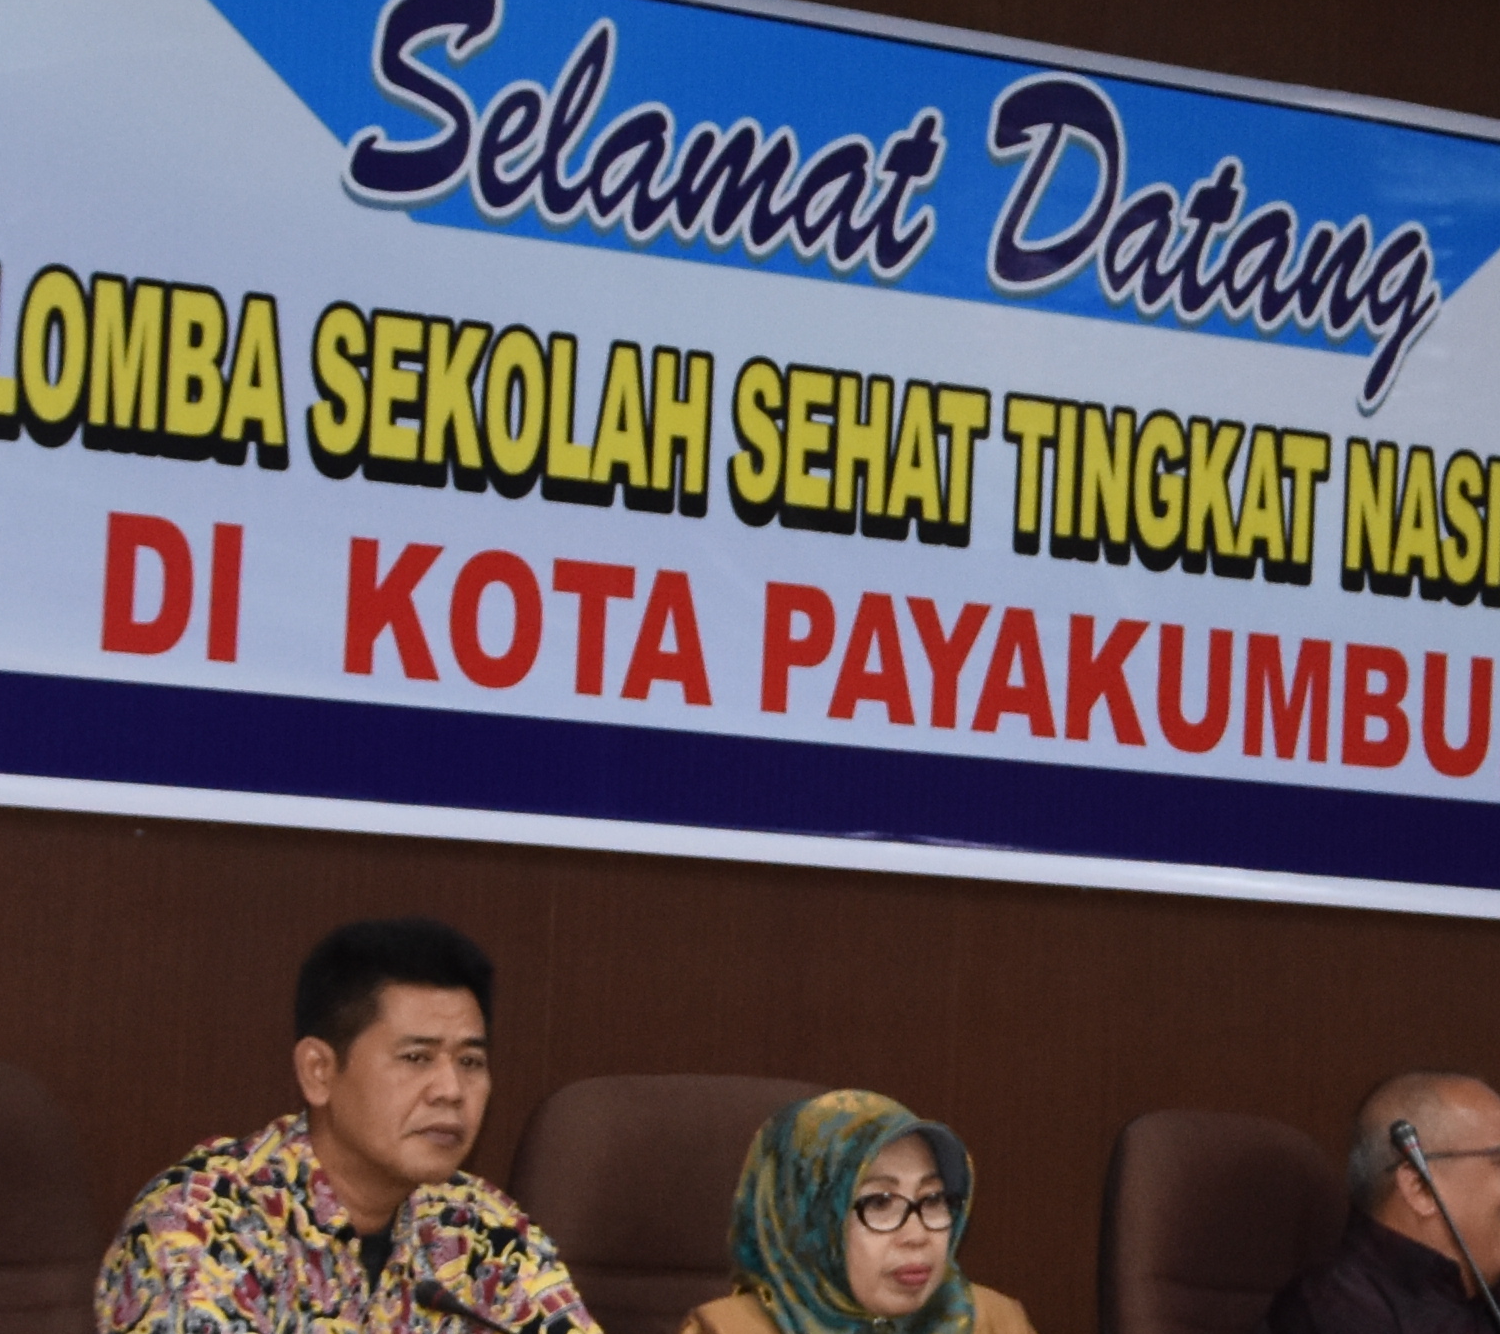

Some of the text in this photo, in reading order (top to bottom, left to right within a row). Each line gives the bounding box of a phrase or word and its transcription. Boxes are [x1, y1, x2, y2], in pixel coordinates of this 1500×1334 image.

[988, 71, 1441, 414] Datang
[307, 302, 714, 505] SEKOLAH
[728, 357, 992, 536] SEHAT
[1002, 392, 1332, 575] TINGKAT
[101, 511, 243, 662] DI
[345, 537, 711, 706] KOTA
